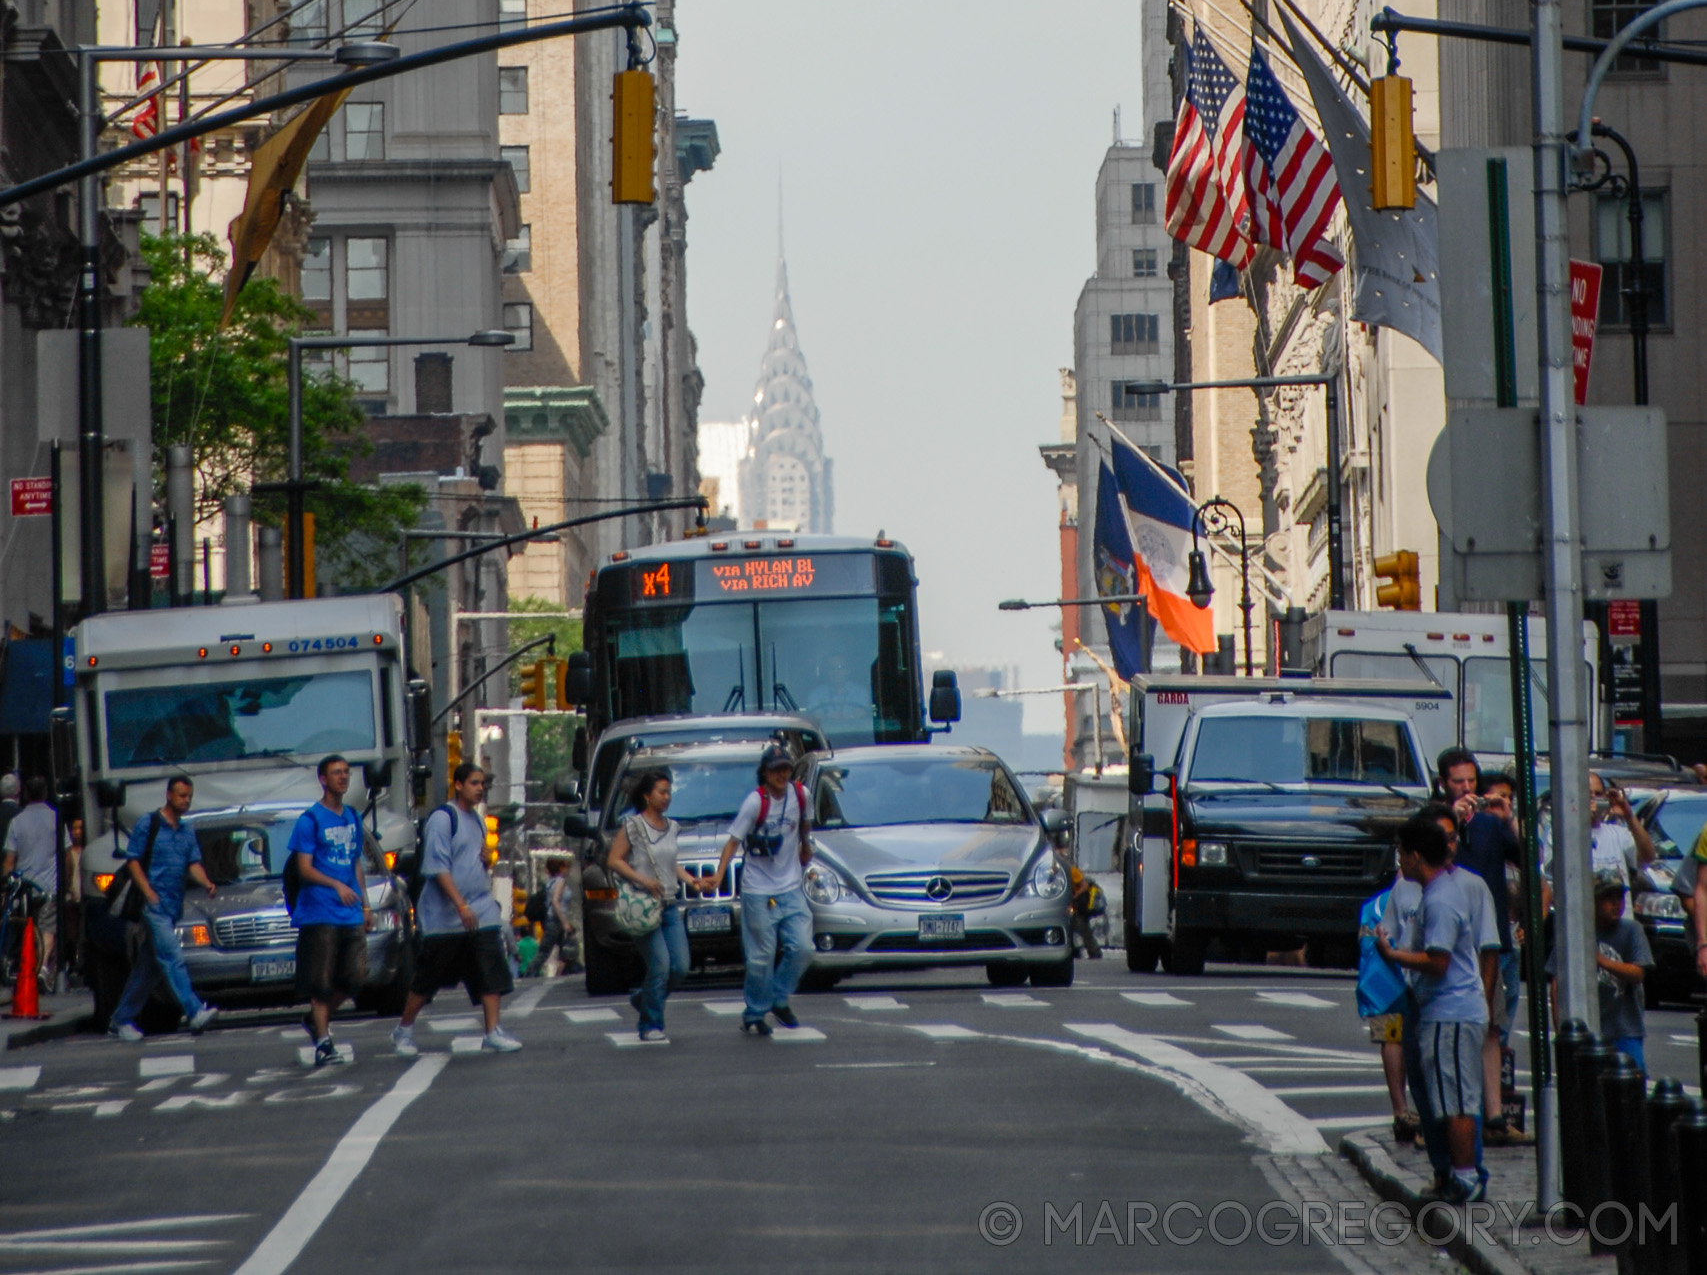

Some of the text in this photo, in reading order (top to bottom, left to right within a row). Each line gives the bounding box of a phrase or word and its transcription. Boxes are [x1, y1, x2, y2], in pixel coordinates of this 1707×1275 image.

[1572, 277, 1587, 305] NO
[13, 482, 24, 491] NO
[713, 558, 816, 577] VIA HYLAN BL
[720, 573, 814, 591] VIA RICH AV
[288, 636, 359, 653] 074504
[1157, 692, 1190, 705] GARDA
[1415, 701, 1440, 711] 5904
